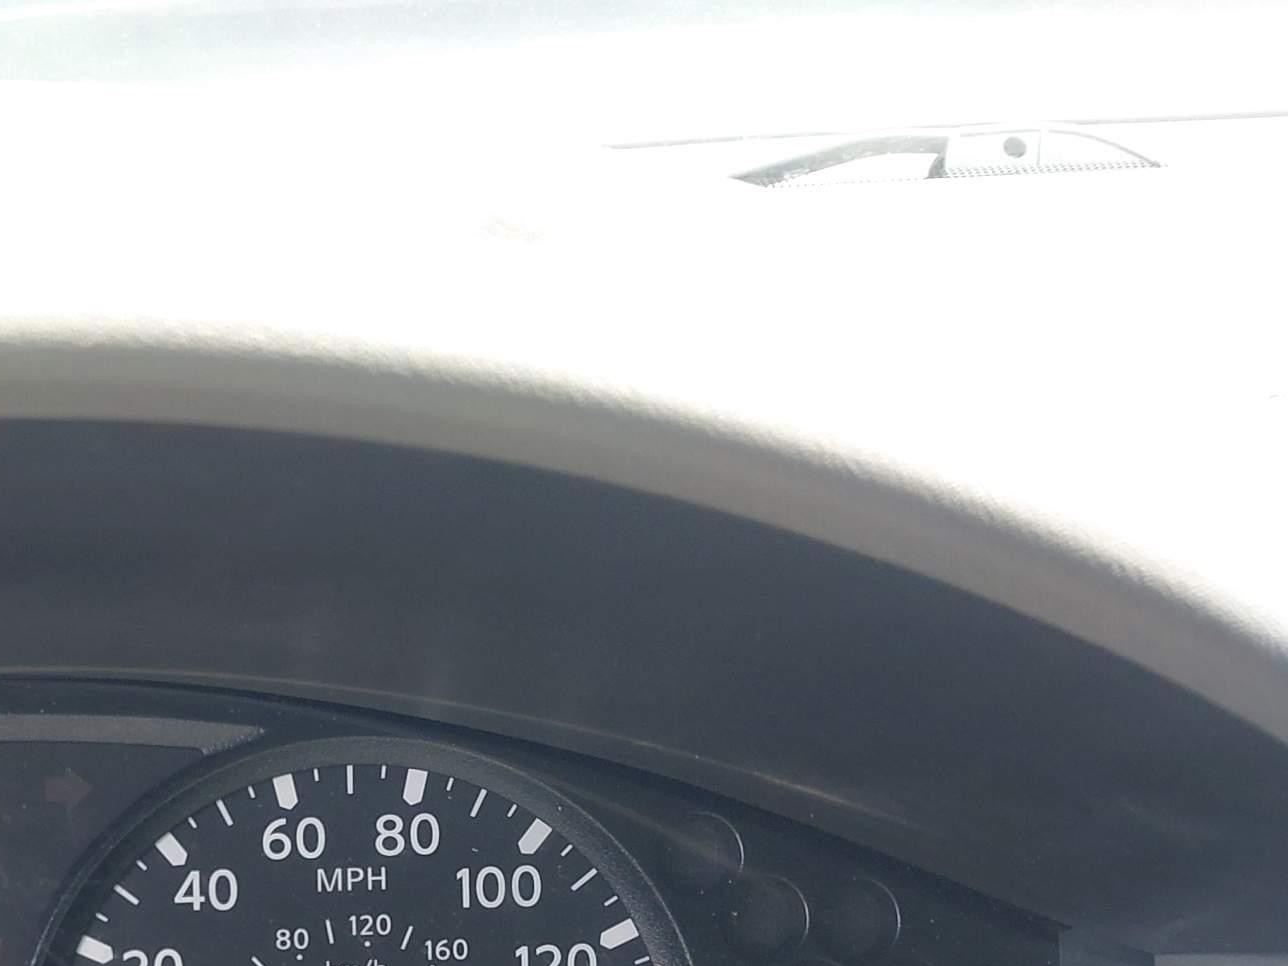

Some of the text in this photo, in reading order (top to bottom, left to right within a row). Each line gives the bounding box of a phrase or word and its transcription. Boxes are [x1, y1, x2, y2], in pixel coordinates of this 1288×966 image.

[263, 817, 325, 859] 60
[375, 813, 439, 856] 80
[175, 869, 237, 910] 40
[318, 867, 385, 892] MPH
[457, 865, 541, 908] 100
[276, 929, 308, 949] 80
[350, 914, 391, 935] 120
[425, 939, 467, 960] 160
